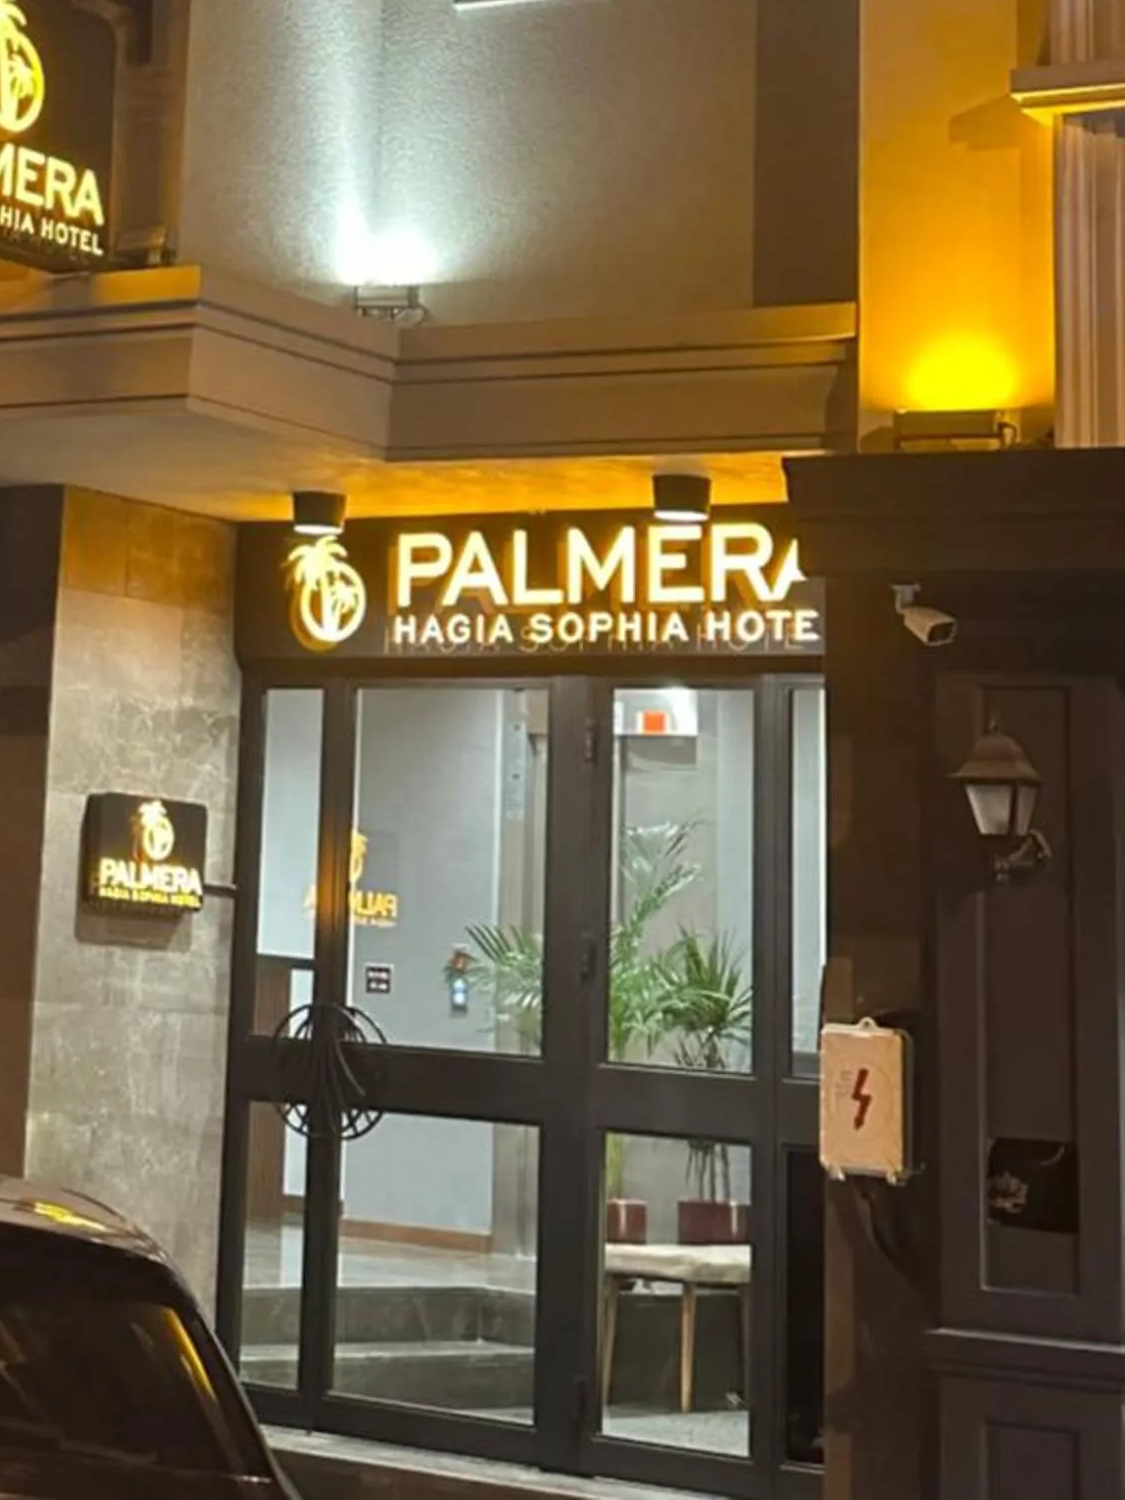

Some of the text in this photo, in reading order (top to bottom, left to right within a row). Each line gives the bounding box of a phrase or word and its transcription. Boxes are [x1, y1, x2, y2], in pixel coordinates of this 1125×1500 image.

[40, 217, 104, 257] HOTEL
[394, 609, 821, 645] HAGIA SOPHIA HOTE
[99, 856, 204, 897] PALMERA
